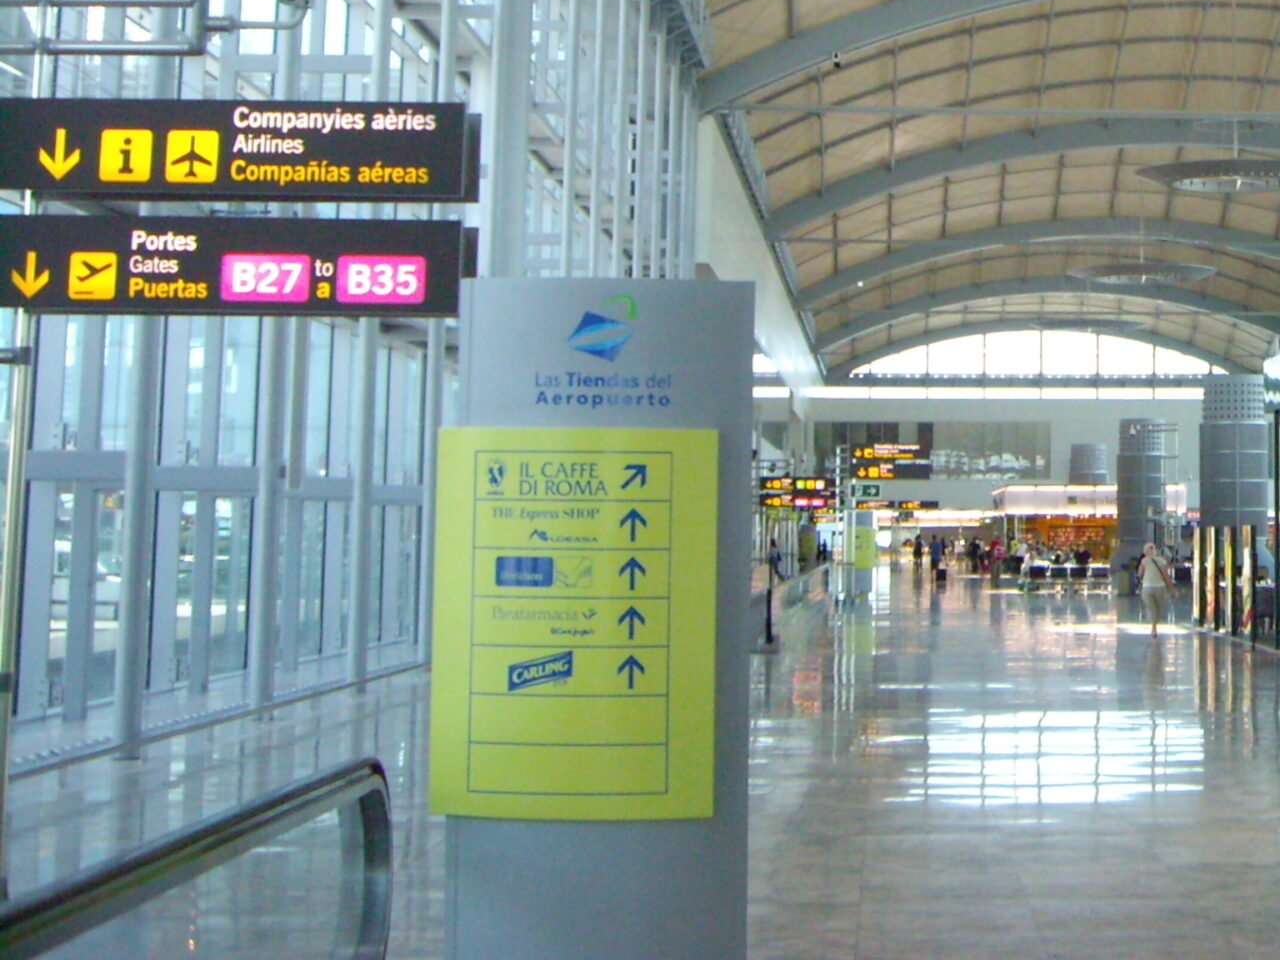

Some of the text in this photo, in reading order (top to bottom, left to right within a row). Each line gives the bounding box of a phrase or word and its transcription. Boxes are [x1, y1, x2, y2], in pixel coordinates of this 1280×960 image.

[233, 106, 437, 133] Companyies aèries
[232, 134, 304, 154] Airlines
[230, 159, 429, 186] Compañías aéreas
[131, 229, 198, 251] Portes
[129, 254, 179, 275] Gates
[231, 258, 418, 296] B27 to B35
[129, 277, 208, 299] Puertas
[316, 282, 331, 299] a
[535, 371, 672, 389] Las Tiendas del
[535, 391, 671, 409] Aeropuerto
[520, 461, 599, 479] IL CAFFE
[519, 480, 609, 497] DI ROMA
[493, 507, 514, 519] THE
[491, 605, 579, 621] Parafarmacia
[512, 659, 571, 684] CARLING
